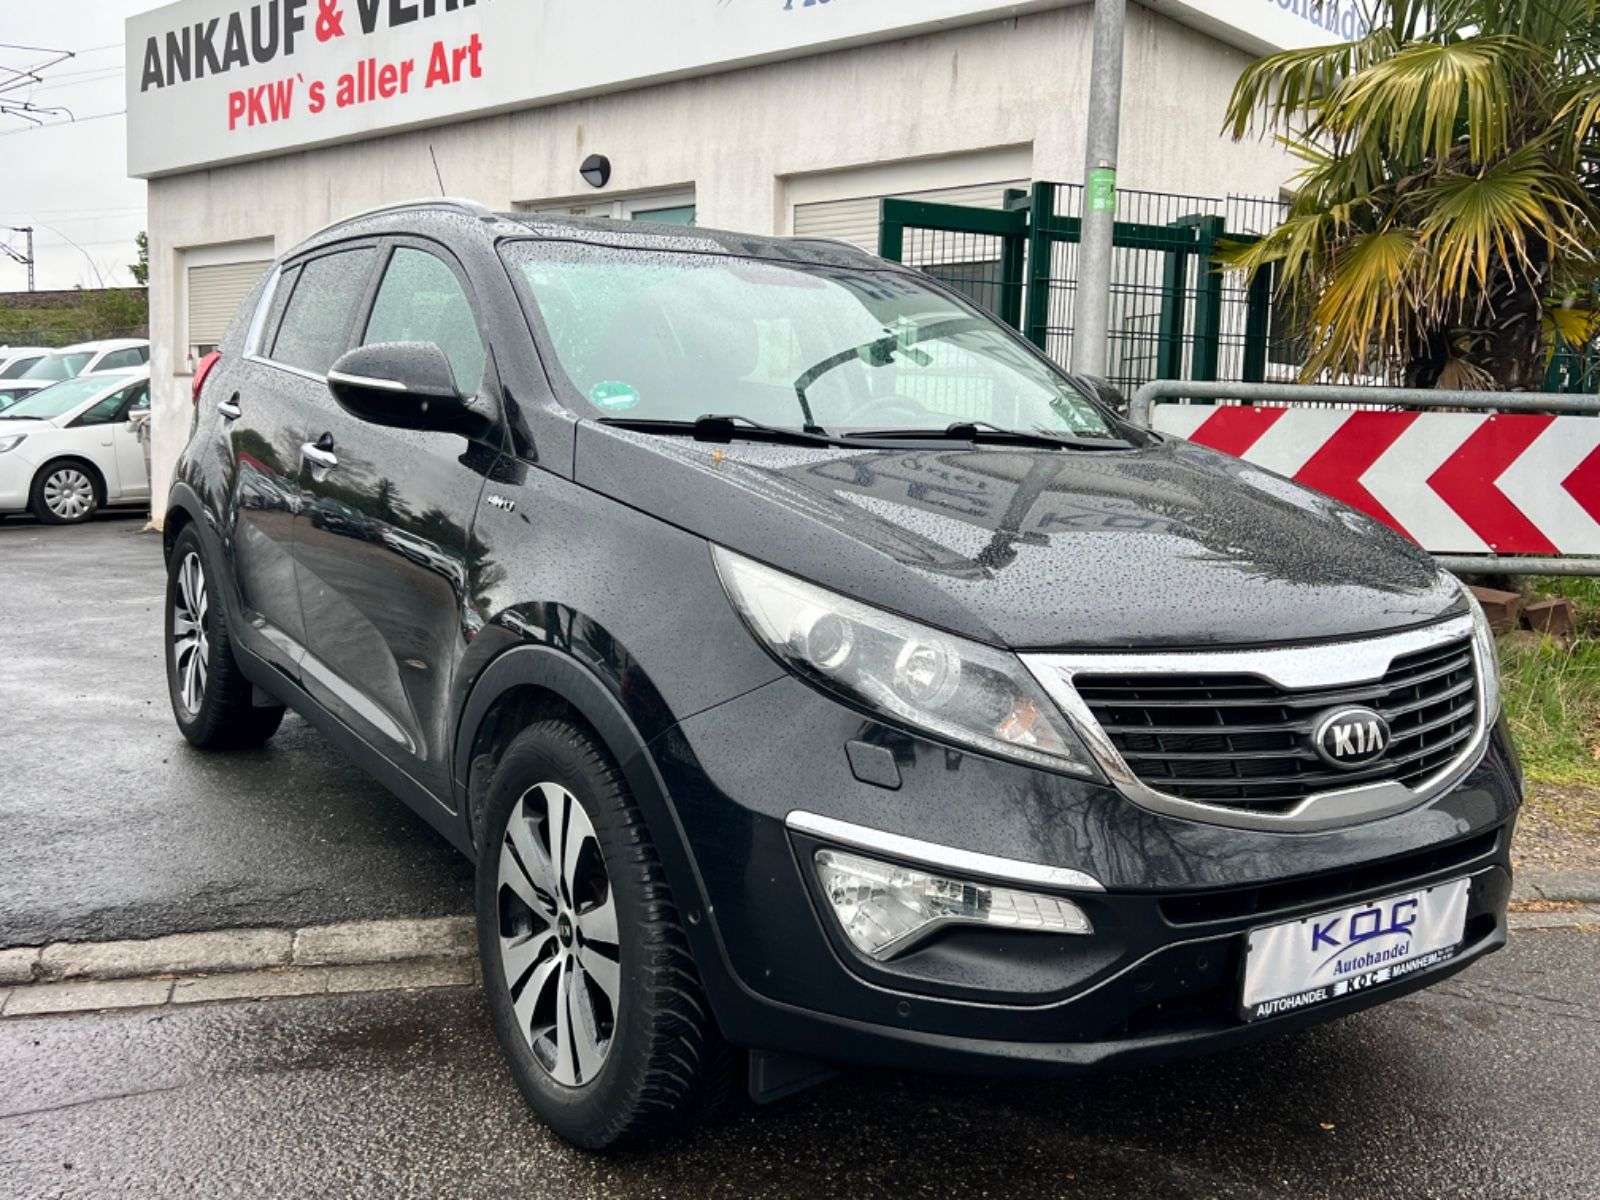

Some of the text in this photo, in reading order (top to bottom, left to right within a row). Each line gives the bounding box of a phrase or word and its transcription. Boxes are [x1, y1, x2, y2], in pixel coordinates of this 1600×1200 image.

[140, 0, 305, 92] ANKAUF
[315, 0, 346, 43] &
[336, 58, 415, 109] aller
[424, 33, 483, 89] Art
[1332, 720, 1383, 756] KIA
[1333, 939, 1409, 976] Autohandel
[1256, 988, 1328, 1017] AUTOHANDEL
